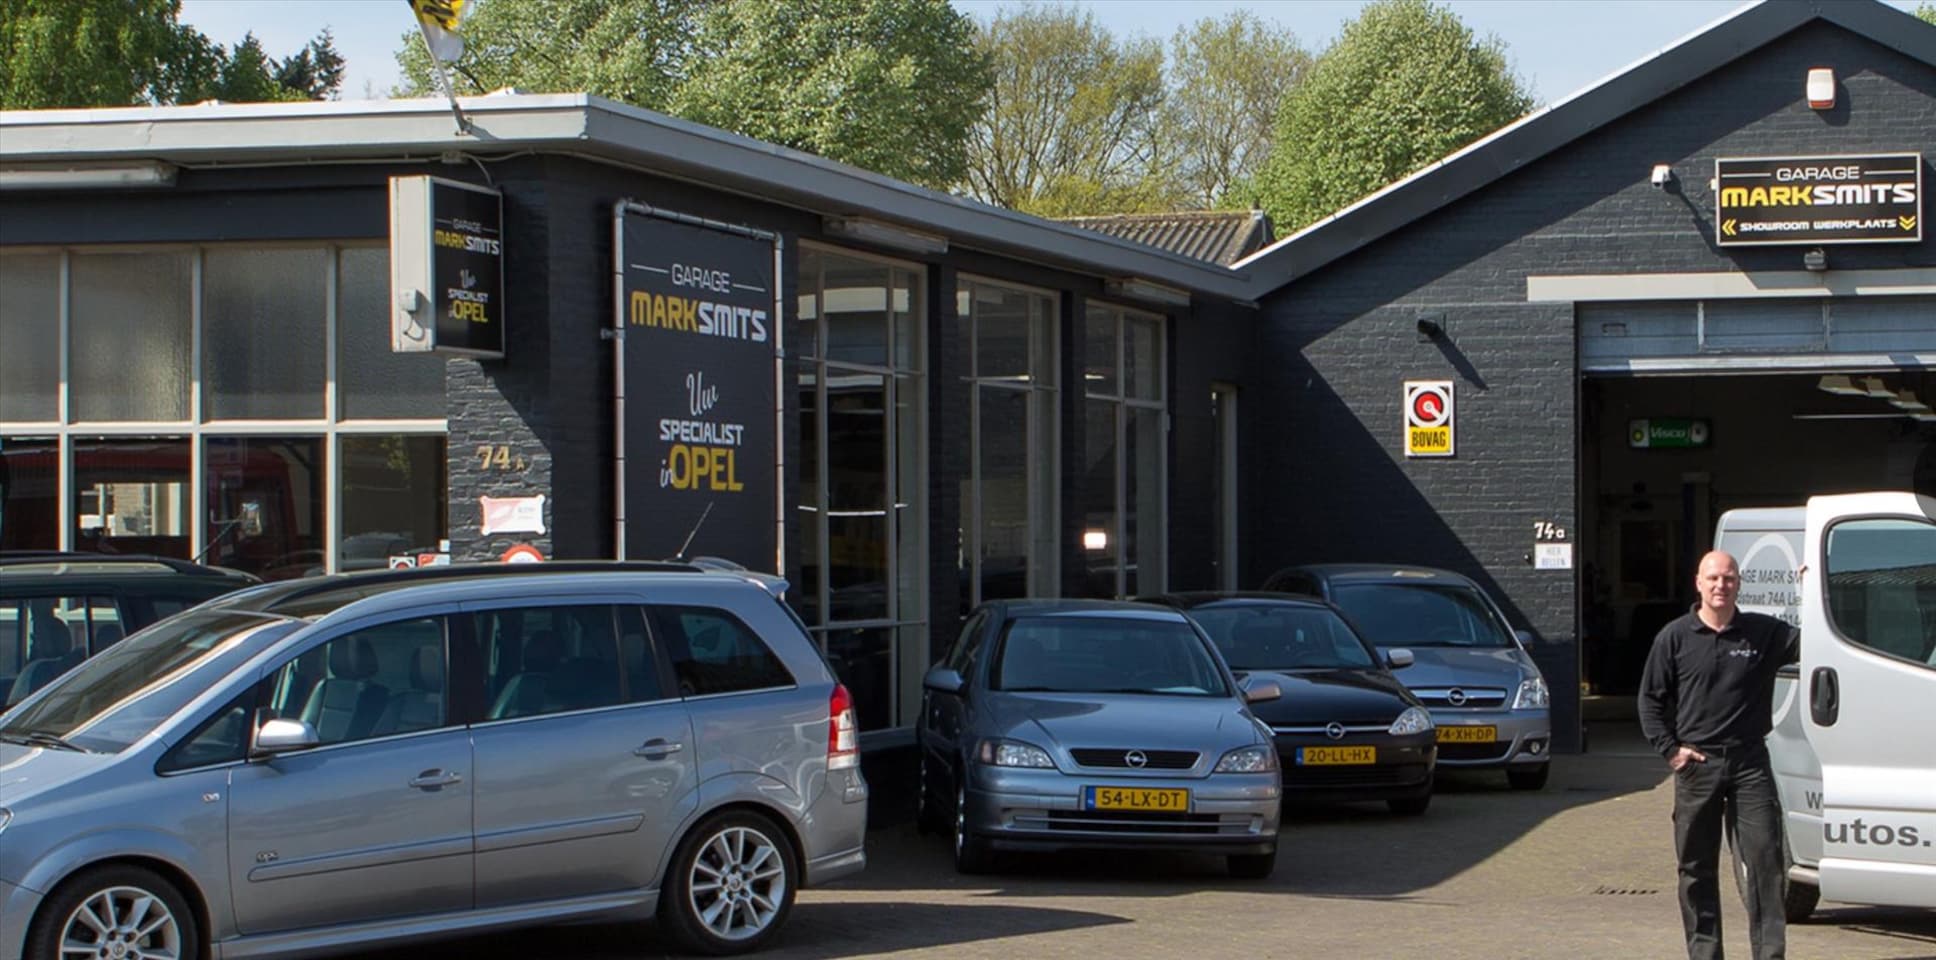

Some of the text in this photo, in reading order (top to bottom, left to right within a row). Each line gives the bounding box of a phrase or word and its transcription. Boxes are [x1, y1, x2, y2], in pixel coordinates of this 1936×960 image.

[1776, 166, 1860, 181] GARAGE
[1721, 184, 1916, 207] MARKSMITS
[453, 218, 482, 234] GARAGE
[1739, 219, 1897, 232] SHOWROOM WERKPLAATS
[671, 263, 731, 293] GARAGE
[448, 288, 489, 303] SPECIALIST
[453, 300, 489, 323] OPEL
[631, 290, 767, 341] MARKSMITS
[686, 371, 720, 416] Uw
[660, 419, 744, 446] SPECIALIST
[1412, 431, 1446, 447] BOVAG
[476, 445, 511, 470] 74
[660, 444, 744, 491] in OPEL
[1759, 569, 1786, 584] MARK
[1308, 749, 1371, 763] 20-LL-HX
[1101, 790, 1181, 807] 54-LX-DT
[1824, 818, 1931, 847] utos.
